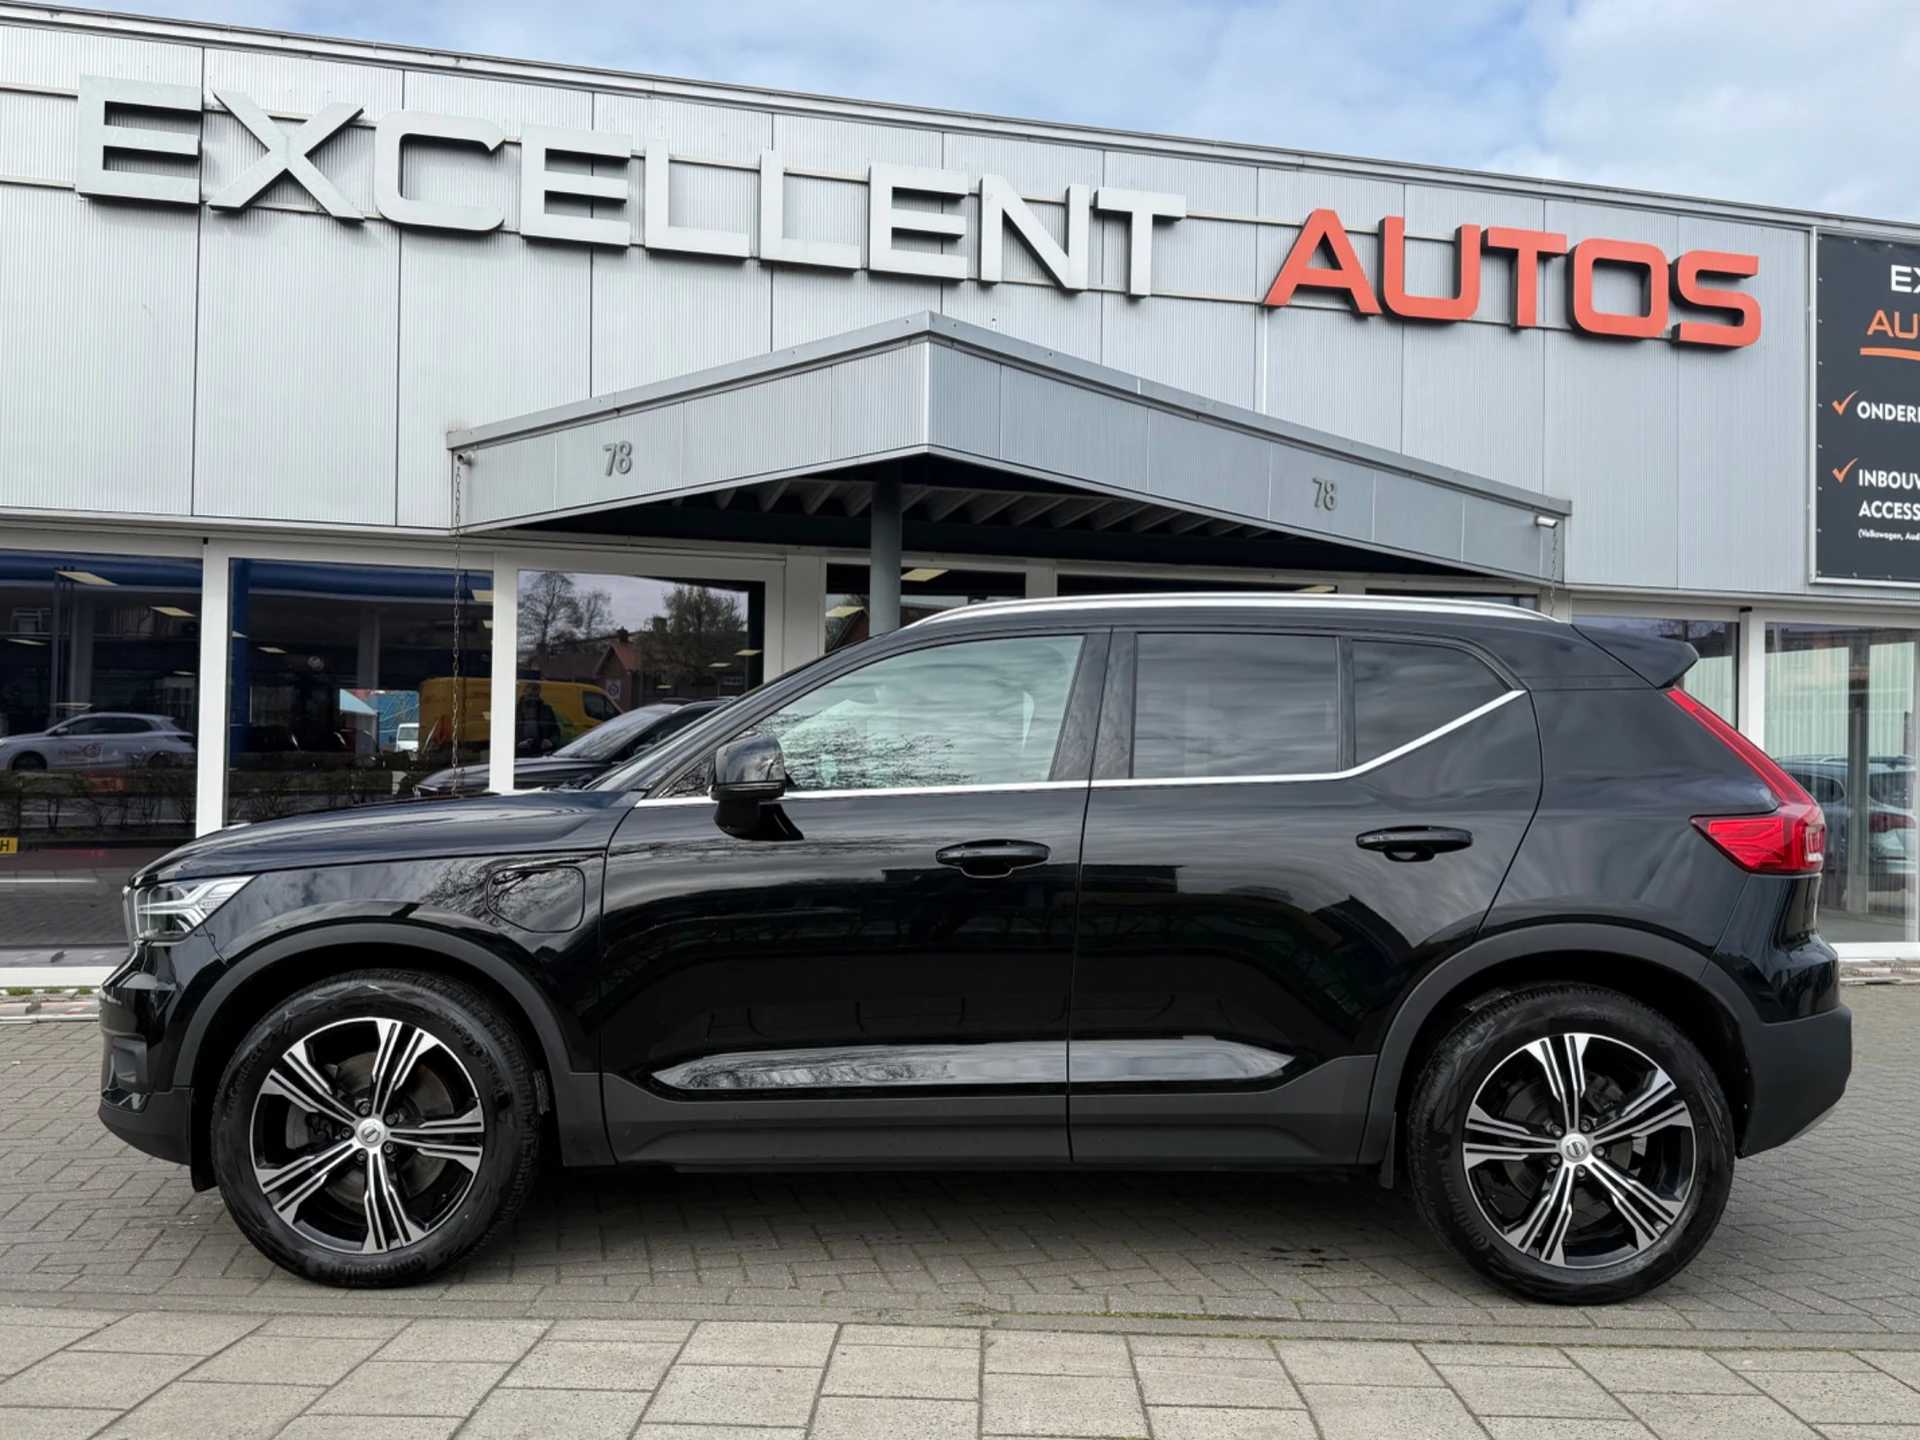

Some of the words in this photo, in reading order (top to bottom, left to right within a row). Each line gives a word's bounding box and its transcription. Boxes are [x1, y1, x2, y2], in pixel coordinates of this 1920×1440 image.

[75, 74, 1187, 298] EXCELLENT
[1261, 208, 1762, 349] AUTOS
[1866, 309, 1920, 340] AU
[1857, 401, 1920, 423] ONDER
[602, 440, 633, 478] 78
[1312, 477, 1338, 512] 78
